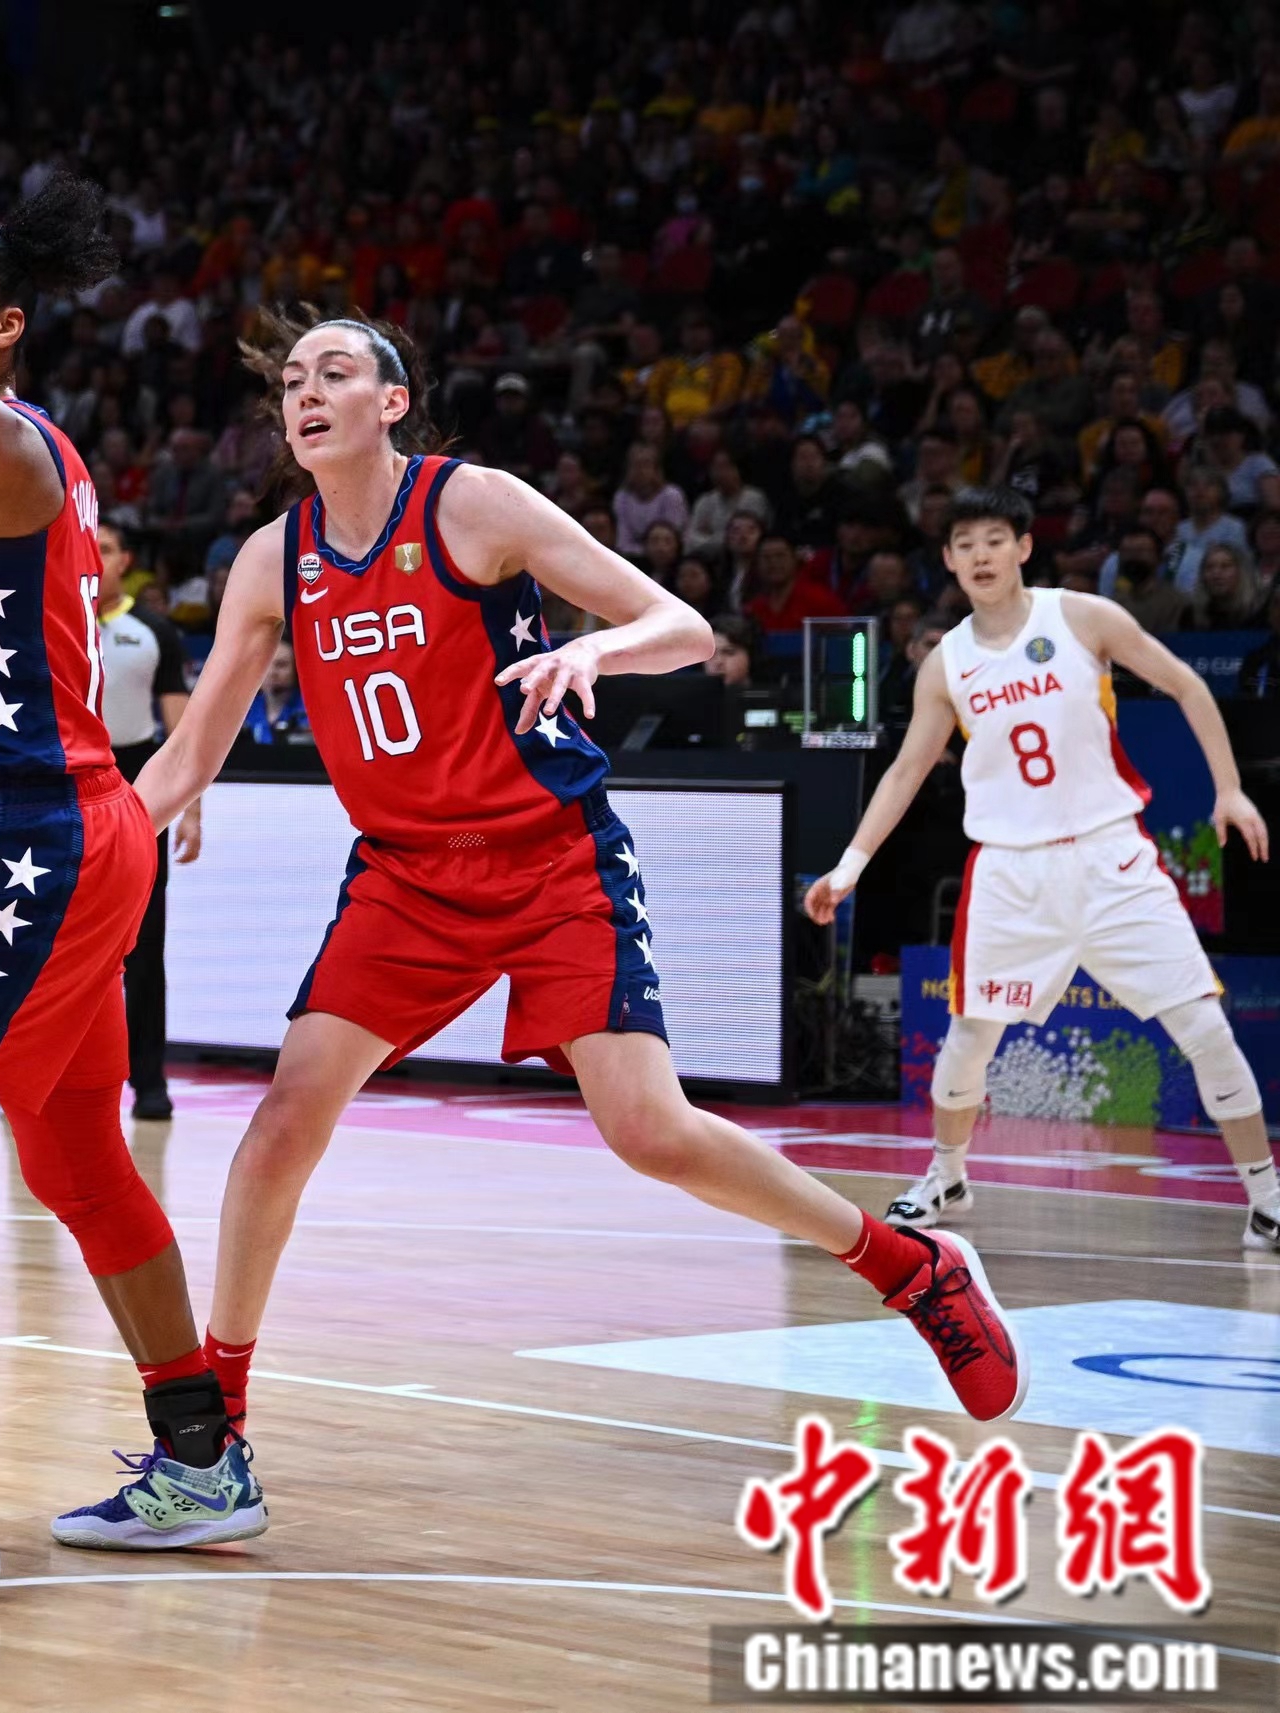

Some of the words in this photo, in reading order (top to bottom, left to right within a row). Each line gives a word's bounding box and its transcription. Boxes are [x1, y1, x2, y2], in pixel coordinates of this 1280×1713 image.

[314, 604, 427, 662] USA
[343, 670, 422, 761] 10
[970, 672, 1064, 714] CHINA
[1009, 722, 1057, 787] 8
[978, 980, 1033, 1008] 中国
